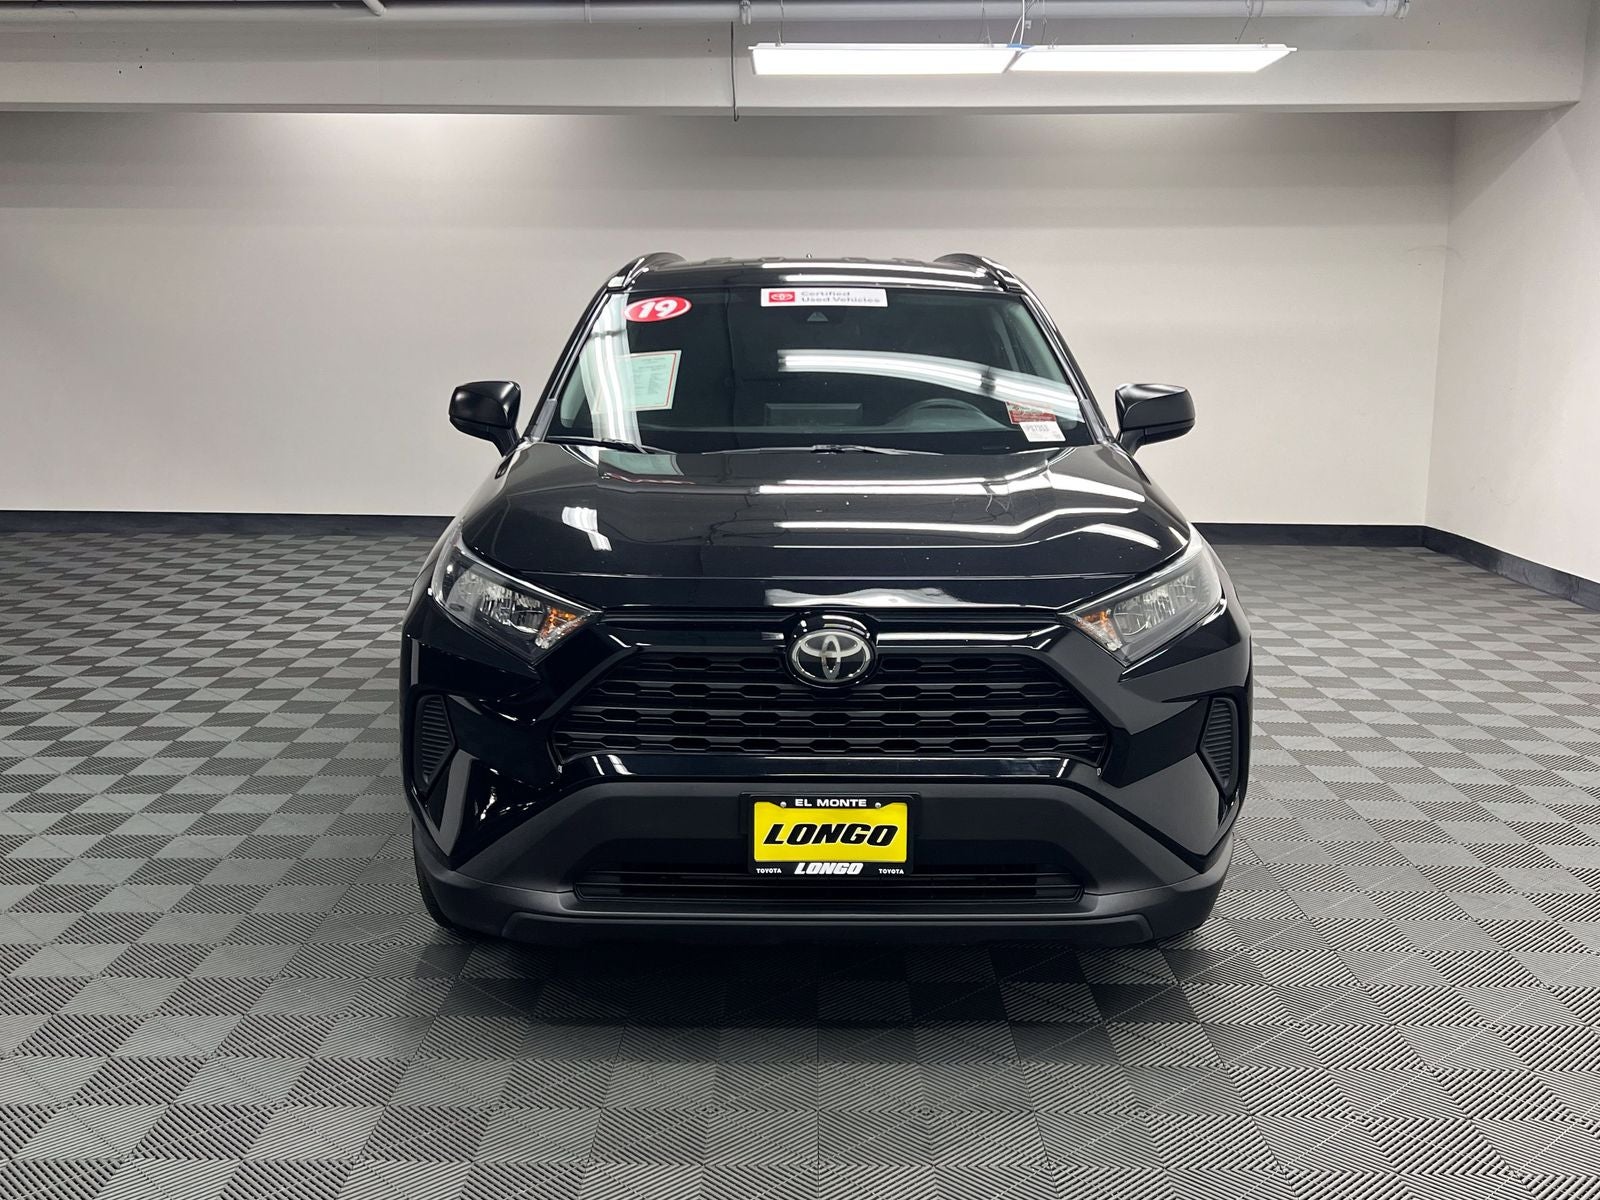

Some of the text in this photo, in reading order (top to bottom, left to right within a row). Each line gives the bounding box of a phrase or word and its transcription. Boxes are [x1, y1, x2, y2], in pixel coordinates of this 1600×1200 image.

[638, 299, 678, 318] 19
[794, 798, 867, 807] EL MONTE
[763, 823, 898, 846] LONGO
[794, 862, 864, 875] LONGO
